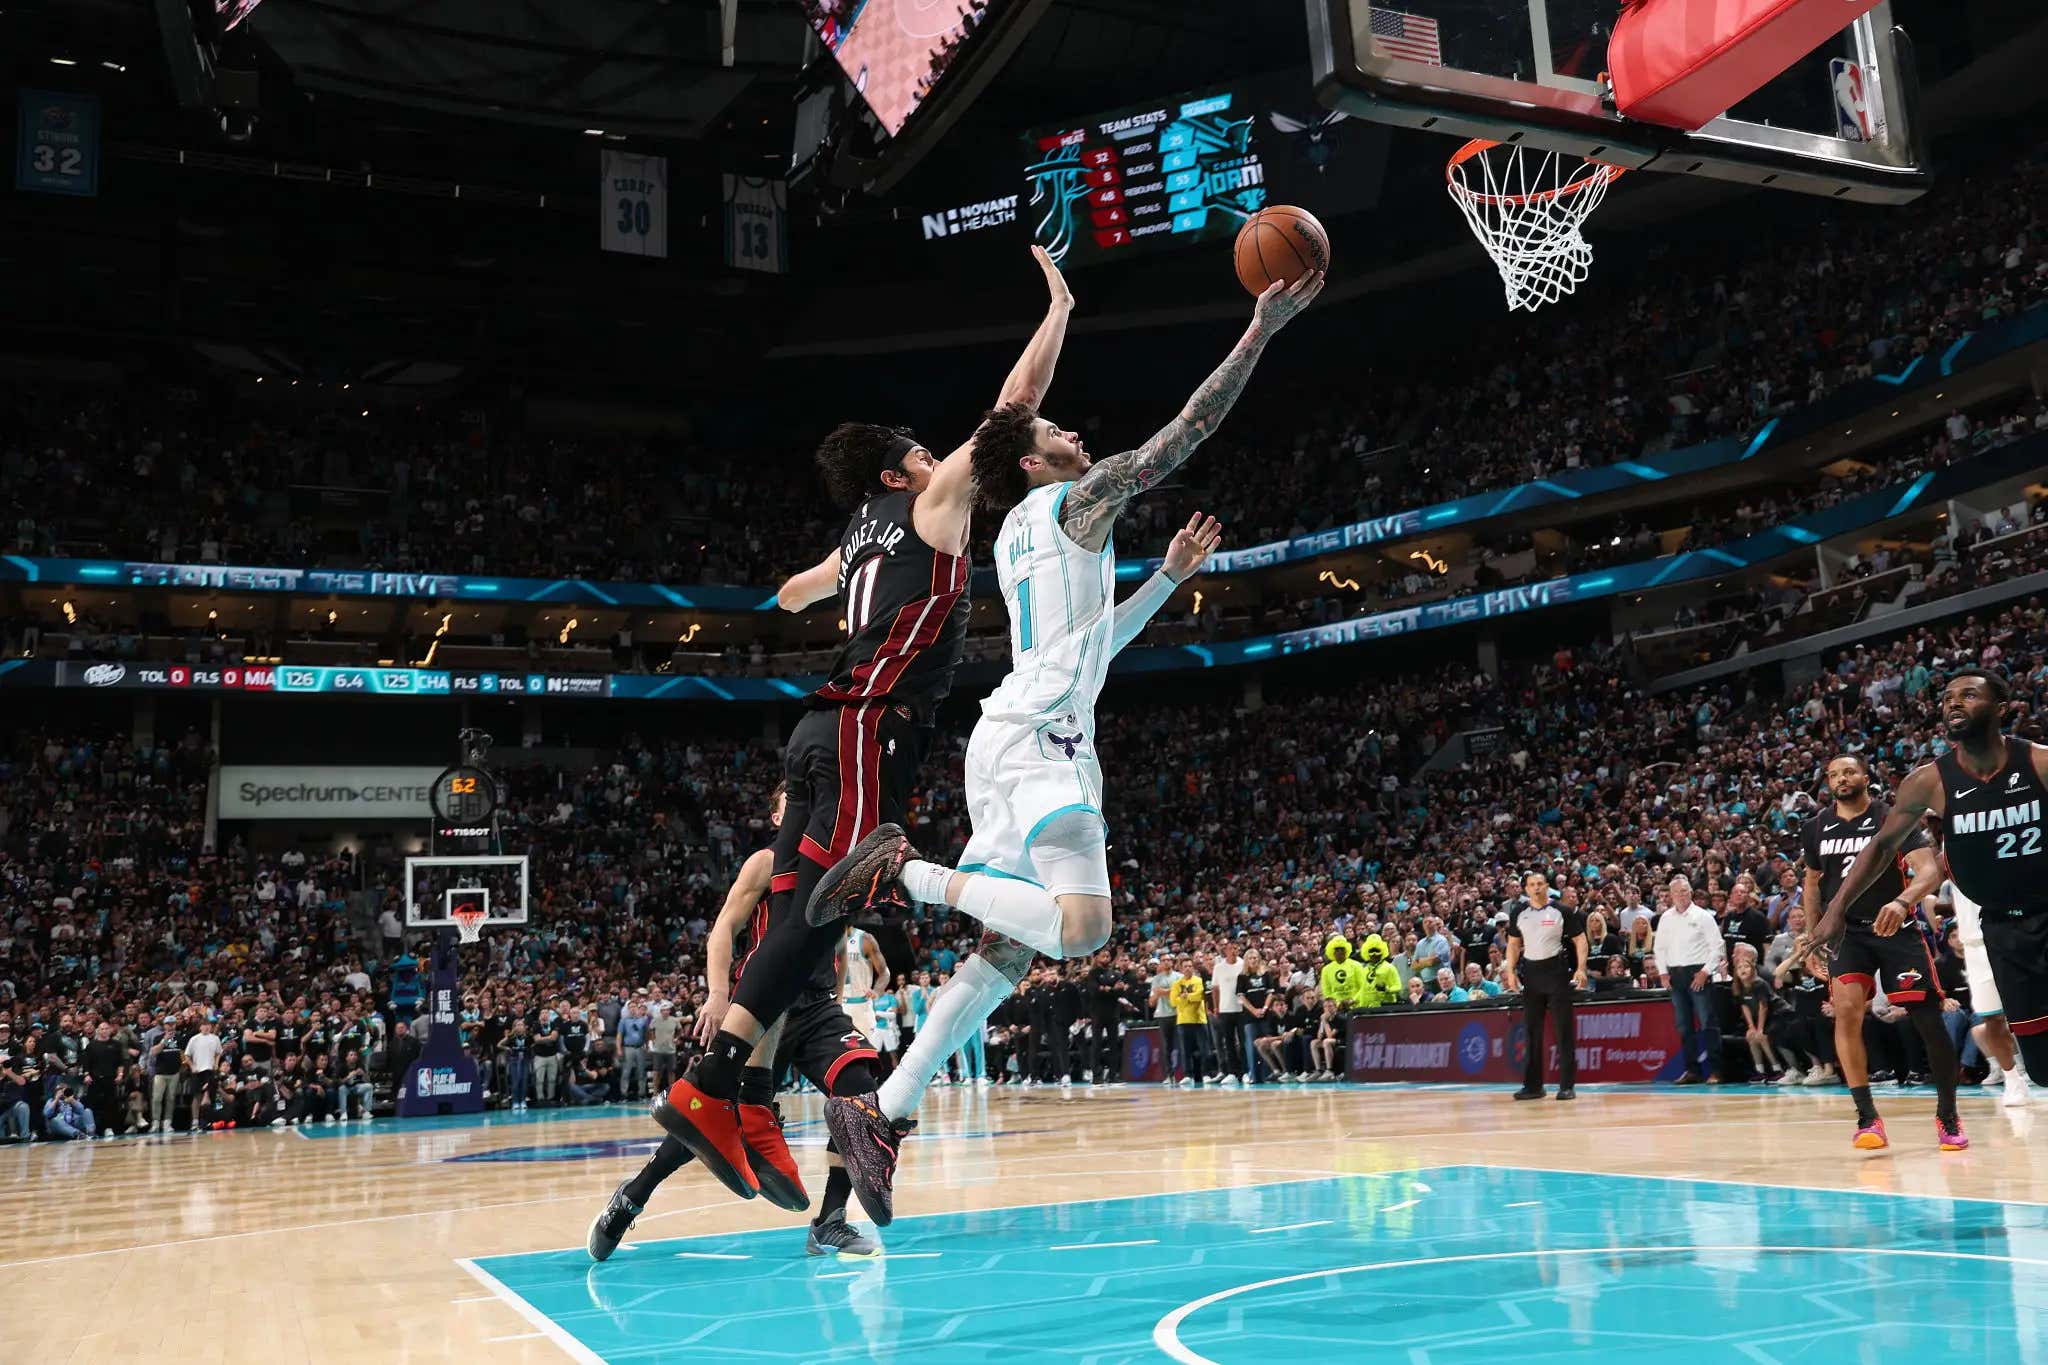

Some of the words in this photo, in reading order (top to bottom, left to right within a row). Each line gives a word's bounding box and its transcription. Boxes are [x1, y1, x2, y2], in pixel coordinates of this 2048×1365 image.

[1098, 116, 1131, 135] TEAM
[1131, 109, 1168, 128] STATS
[33, 143, 82, 175] 32
[1094, 152, 1110, 164] 32
[1103, 171, 1112, 182] 8
[617, 198, 651, 236] 30
[959, 194, 1019, 219] NOVANT
[1133, 202, 1161, 216] STEALS
[961, 209, 1017, 232] HEALTH
[741, 222, 769, 259] 13
[1113, 232, 1122, 243] 7
[877, 521, 905, 557] JR.
[1294, 531, 1341, 553] THE
[1345, 511, 1421, 547] HIVE
[1009, 527, 1035, 566] BALL
[309, 573, 365, 591] THE
[371, 572, 460, 596] HIVE
[847, 555, 882, 637] 11
[1427, 600, 1478, 625] THE
[1483, 577, 1571, 617] HIVE
[1016, 576, 1033, 653] 1
[137, 671, 168, 683] TOL
[170, 670, 184, 684] 0
[193, 671, 219, 685] FLS
[224, 671, 236, 684] 0
[244, 671, 277, 686] MIA
[286, 672, 315, 687] 126
[333, 673, 364, 688] 6.4
[383, 674, 410, 688] 125
[416, 675, 450, 689] CHA
[454, 677, 478, 690] FLS
[499, 678, 524, 691] TOL
[530, 679, 541, 691] 0
[239, 782, 354, 806] Spectrum
[359, 786, 430, 802] CENTE
[1953, 799, 2041, 835] MIAMI
[453, 828, 490, 837] TISSOT
[1996, 827, 2043, 859] 22
[1819, 836, 1872, 856] MIAM
[1576, 1012, 1641, 1040] TOMORROW
[1589, 1046, 1603, 1071] ET
[1605, 1049, 1625, 1063] Only
[1637, 1050, 1667, 1063] prime
